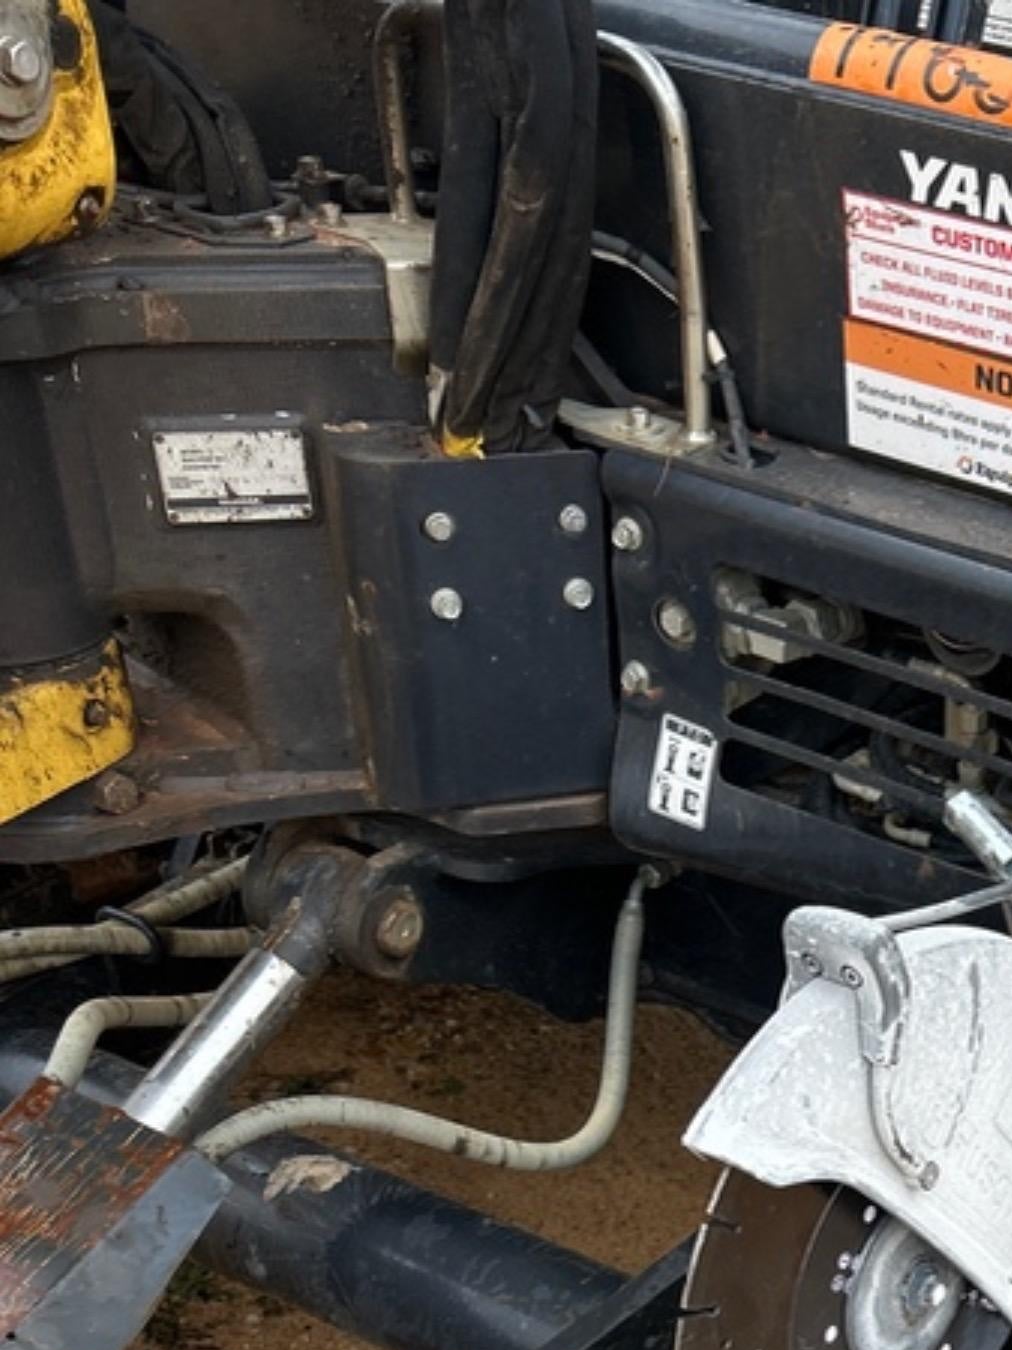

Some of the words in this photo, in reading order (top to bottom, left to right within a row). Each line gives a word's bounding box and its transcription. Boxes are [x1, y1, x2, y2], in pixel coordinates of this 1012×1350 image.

[861, 250, 897, 270] CHECK
[902, 261, 920, 276] ALL
[962, 276, 1002, 297] LEVELS
[858, 296, 903, 318] DAMAGE
[908, 309, 920, 323] TO
[925, 314, 993, 342] EQUIPMENT
[881, 279, 947, 306] INSURANCE
[957, 299, 983, 316] FLAT
[856, 380, 905, 405] Standard
[910, 396, 944, 416] Rental
[947, 409, 977, 426] rates
[980, 420, 1011, 438] apply
[857, 401, 889, 421] Usage
[893, 411, 948, 438] exceeding
[981, 438, 999, 452] per
